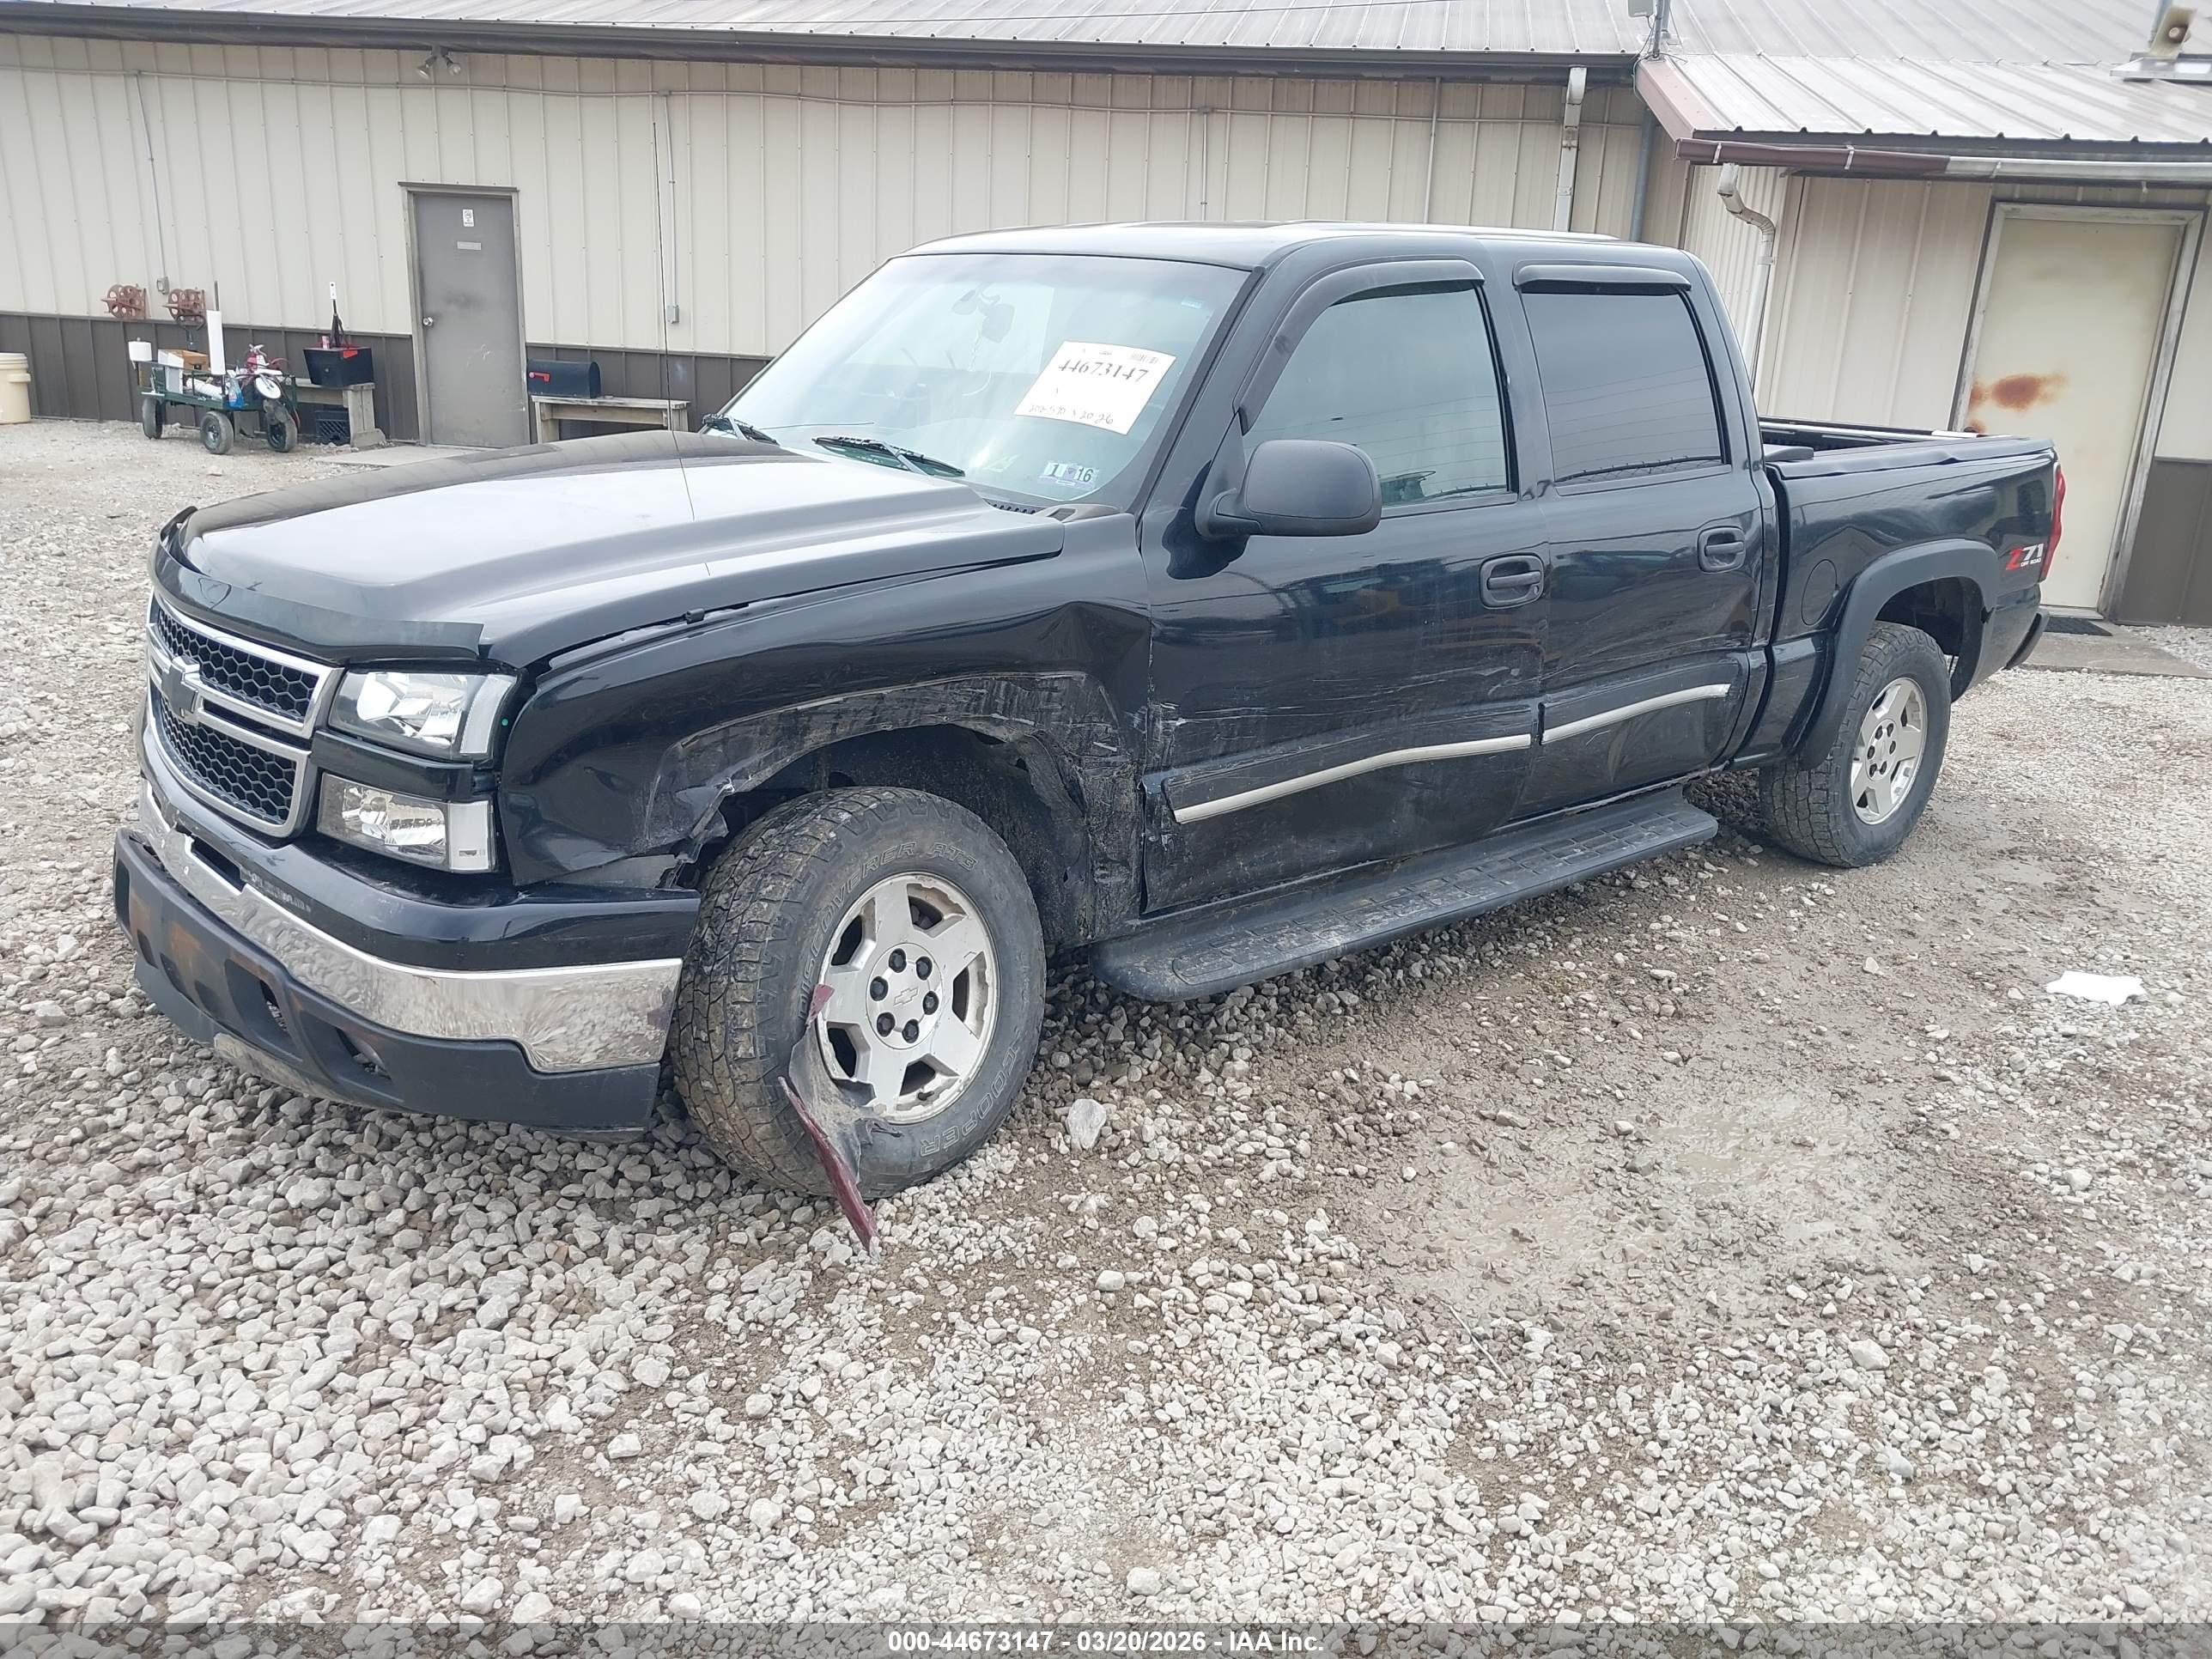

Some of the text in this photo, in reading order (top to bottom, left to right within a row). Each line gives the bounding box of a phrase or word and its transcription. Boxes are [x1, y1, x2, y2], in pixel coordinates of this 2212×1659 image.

[1059, 359, 1149, 383] 44673147
[1077, 467, 1094, 483] 16
[2005, 543, 2045, 571] Z71
[798, 842, 916, 1019] DISCOVERER
[927, 842, 979, 872] AT3
[919, 1044, 1020, 1158] COOPER
